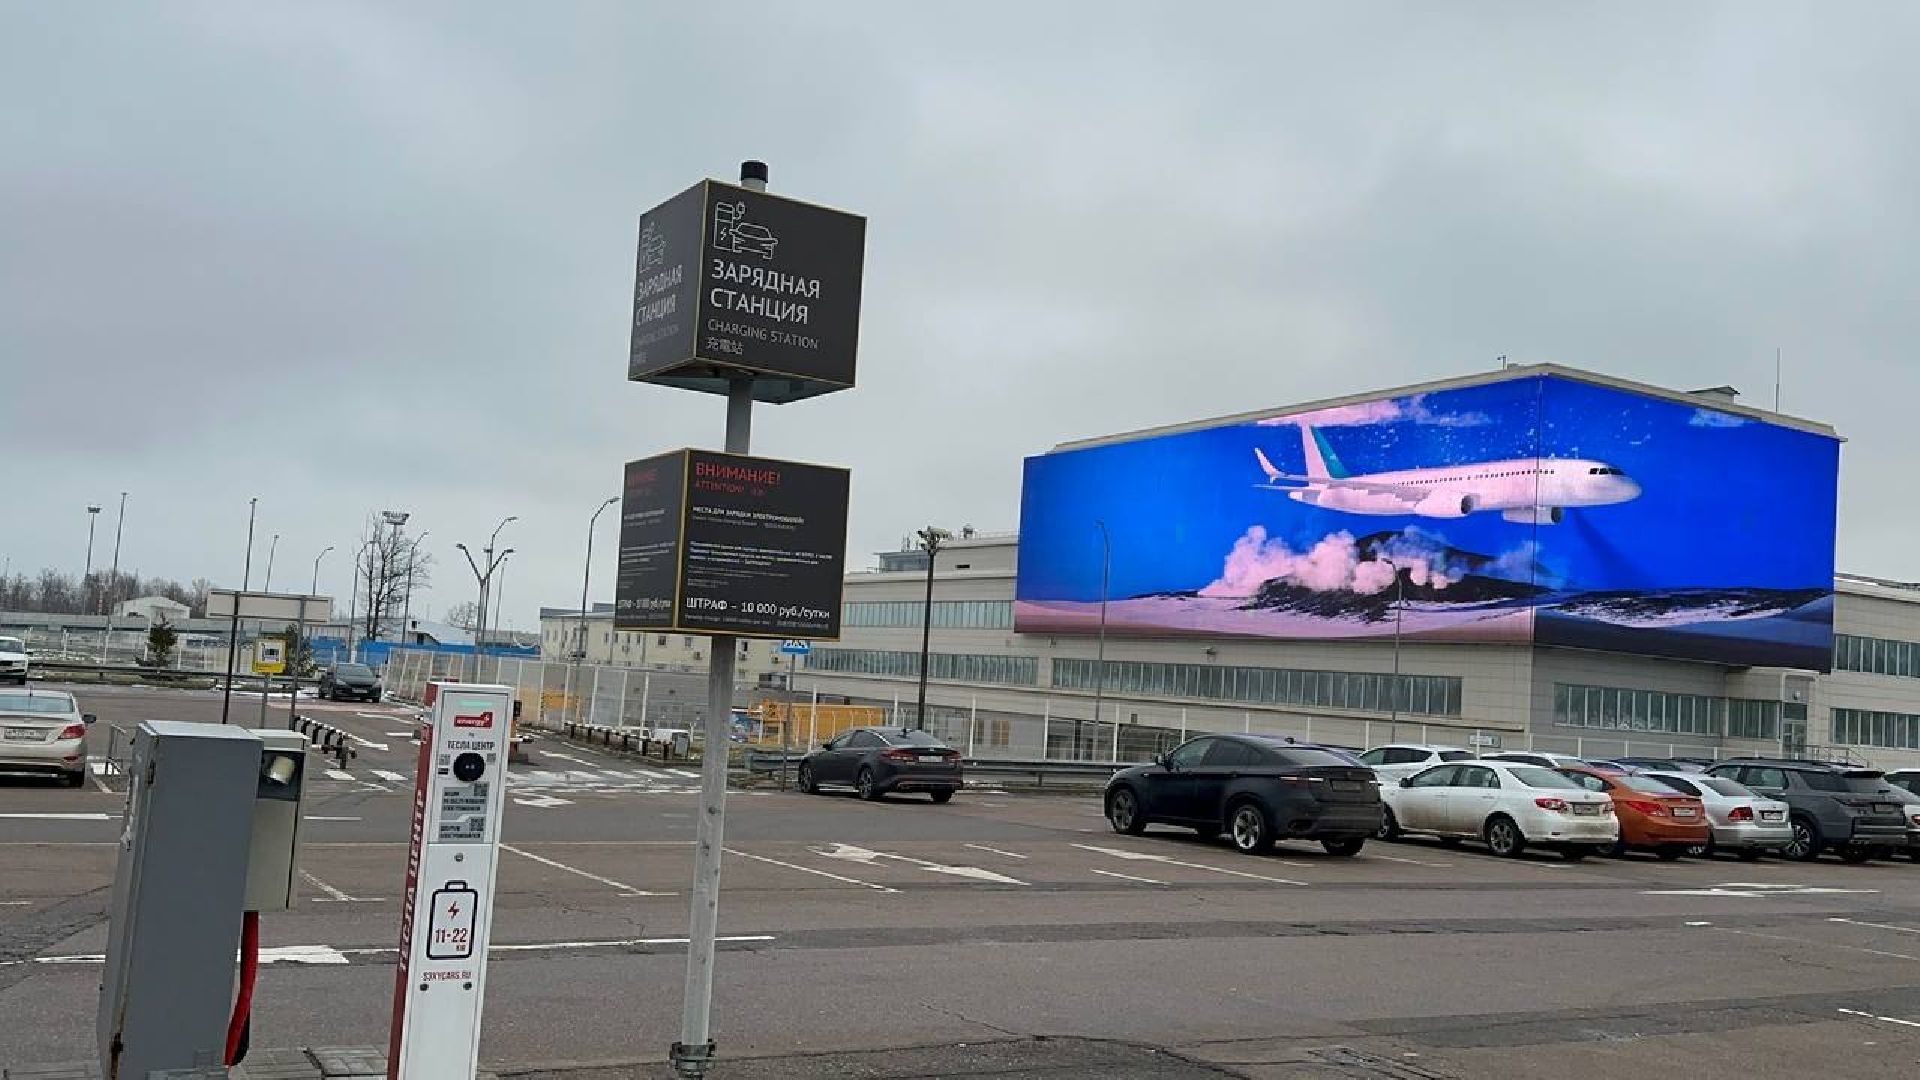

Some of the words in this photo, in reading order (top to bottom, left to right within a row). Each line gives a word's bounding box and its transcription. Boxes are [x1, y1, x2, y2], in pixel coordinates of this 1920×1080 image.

[711, 259, 821, 299] ЗАРЯДНАЯ
[636, 294, 676, 326] СТАНЦИЯ
[710, 288, 808, 325] СТАНЦИЯ
[707, 318, 767, 340] CHARGING
[770, 331, 818, 349] STATION
[696, 462, 781, 485] ВНИМАНИЕ!
[686, 597, 728, 610] ШТРАФ
[741, 602, 754, 613] 10
[756, 603, 777, 614] 000
[471, 741, 495, 750] ЦЕНТР
[435, 927, 467, 943] 11-22
